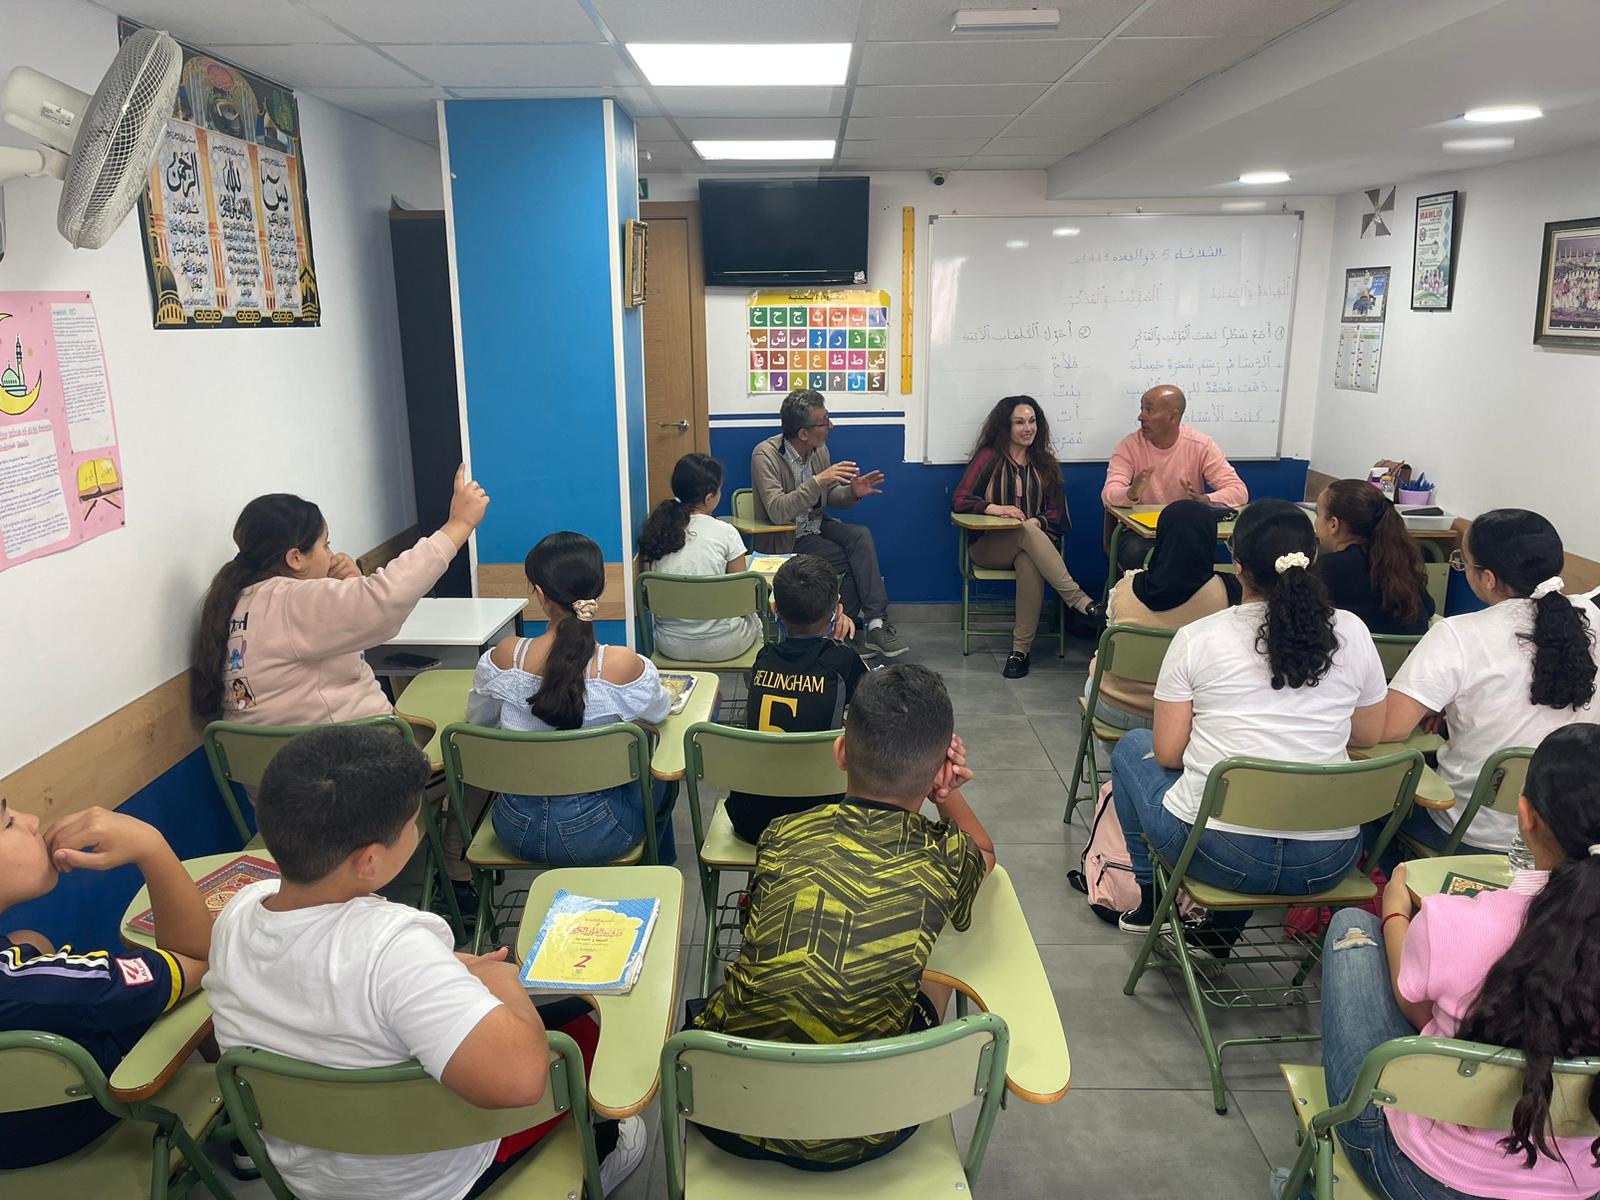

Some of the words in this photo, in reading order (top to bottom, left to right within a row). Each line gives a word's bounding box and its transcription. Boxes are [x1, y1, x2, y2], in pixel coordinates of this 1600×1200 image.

[753, 308, 764, 324] خ
[773, 311, 784, 324] ح
[793, 311, 804, 324] ج
[812, 309, 824, 322] ث
[832, 311, 844, 322] ت
[852, 314, 864, 326] ب
[749, 335, 767, 346] ص
[770, 330, 786, 346] ش
[790, 336, 806, 346] س
[813, 330, 823, 346] ز
[834, 335, 843, 346] ر
[854, 331, 861, 344] ذ
[873, 335, 881, 343] د
[772, 353, 785, 365] ف
[793, 351, 803, 368] غ
[812, 354, 822, 368] ع
[831, 353, 844, 366] ظ
[850, 354, 864, 365] ط
[775, 376, 784, 388] و
[812, 375, 823, 389] ن
[833, 375, 841, 387] م
[851, 375, 861, 389] ل
[753, 669, 825, 694] BELLINGHAM
[573, 954, 593, 969] 2
